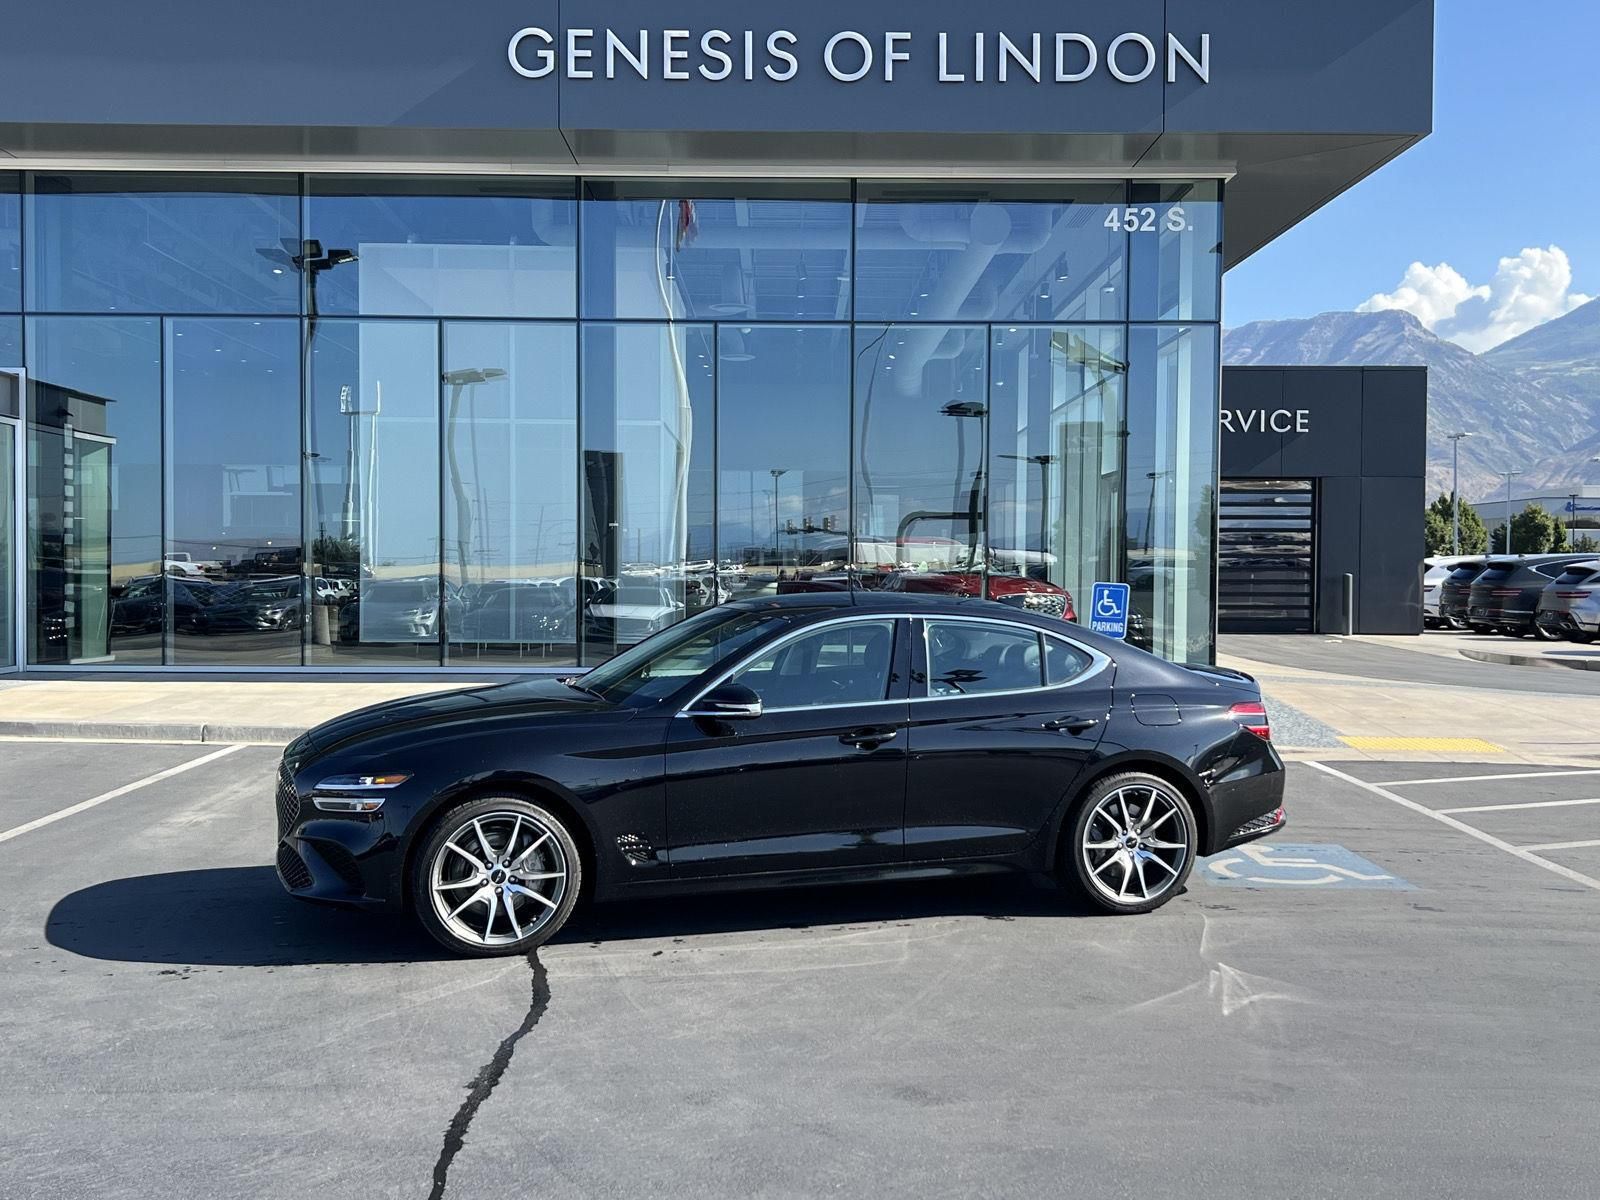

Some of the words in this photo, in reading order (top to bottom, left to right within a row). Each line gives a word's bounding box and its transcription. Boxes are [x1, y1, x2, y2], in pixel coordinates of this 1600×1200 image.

[507, 27, 799, 81] GENESIS
[823, 30, 912, 83] OF
[938, 31, 1210, 84] LINDON
[1103, 207, 1156, 232] 452
[1166, 206, 1194, 232] S.
[1220, 409, 1310, 433] RVICE
[1091, 620, 1124, 633] PARKING
